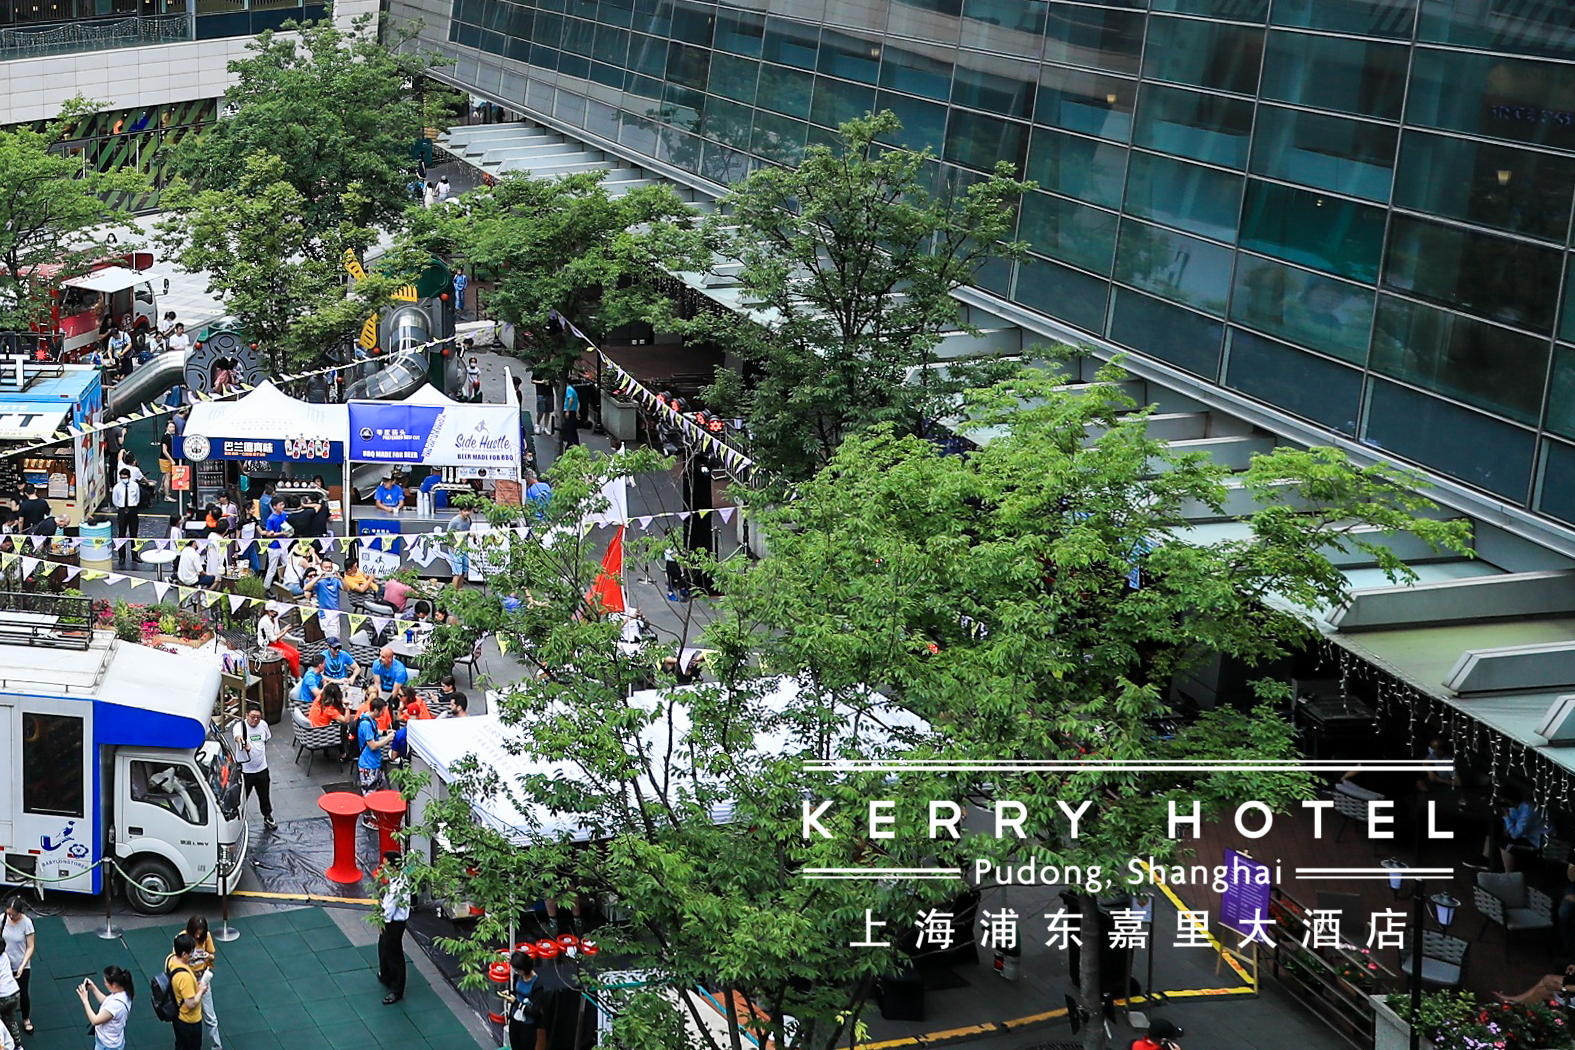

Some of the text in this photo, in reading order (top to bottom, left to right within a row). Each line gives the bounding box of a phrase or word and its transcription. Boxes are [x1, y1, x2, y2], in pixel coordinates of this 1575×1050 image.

[455, 433, 511, 449] Side Hustle
[377, 565, 398, 576] Hustl
